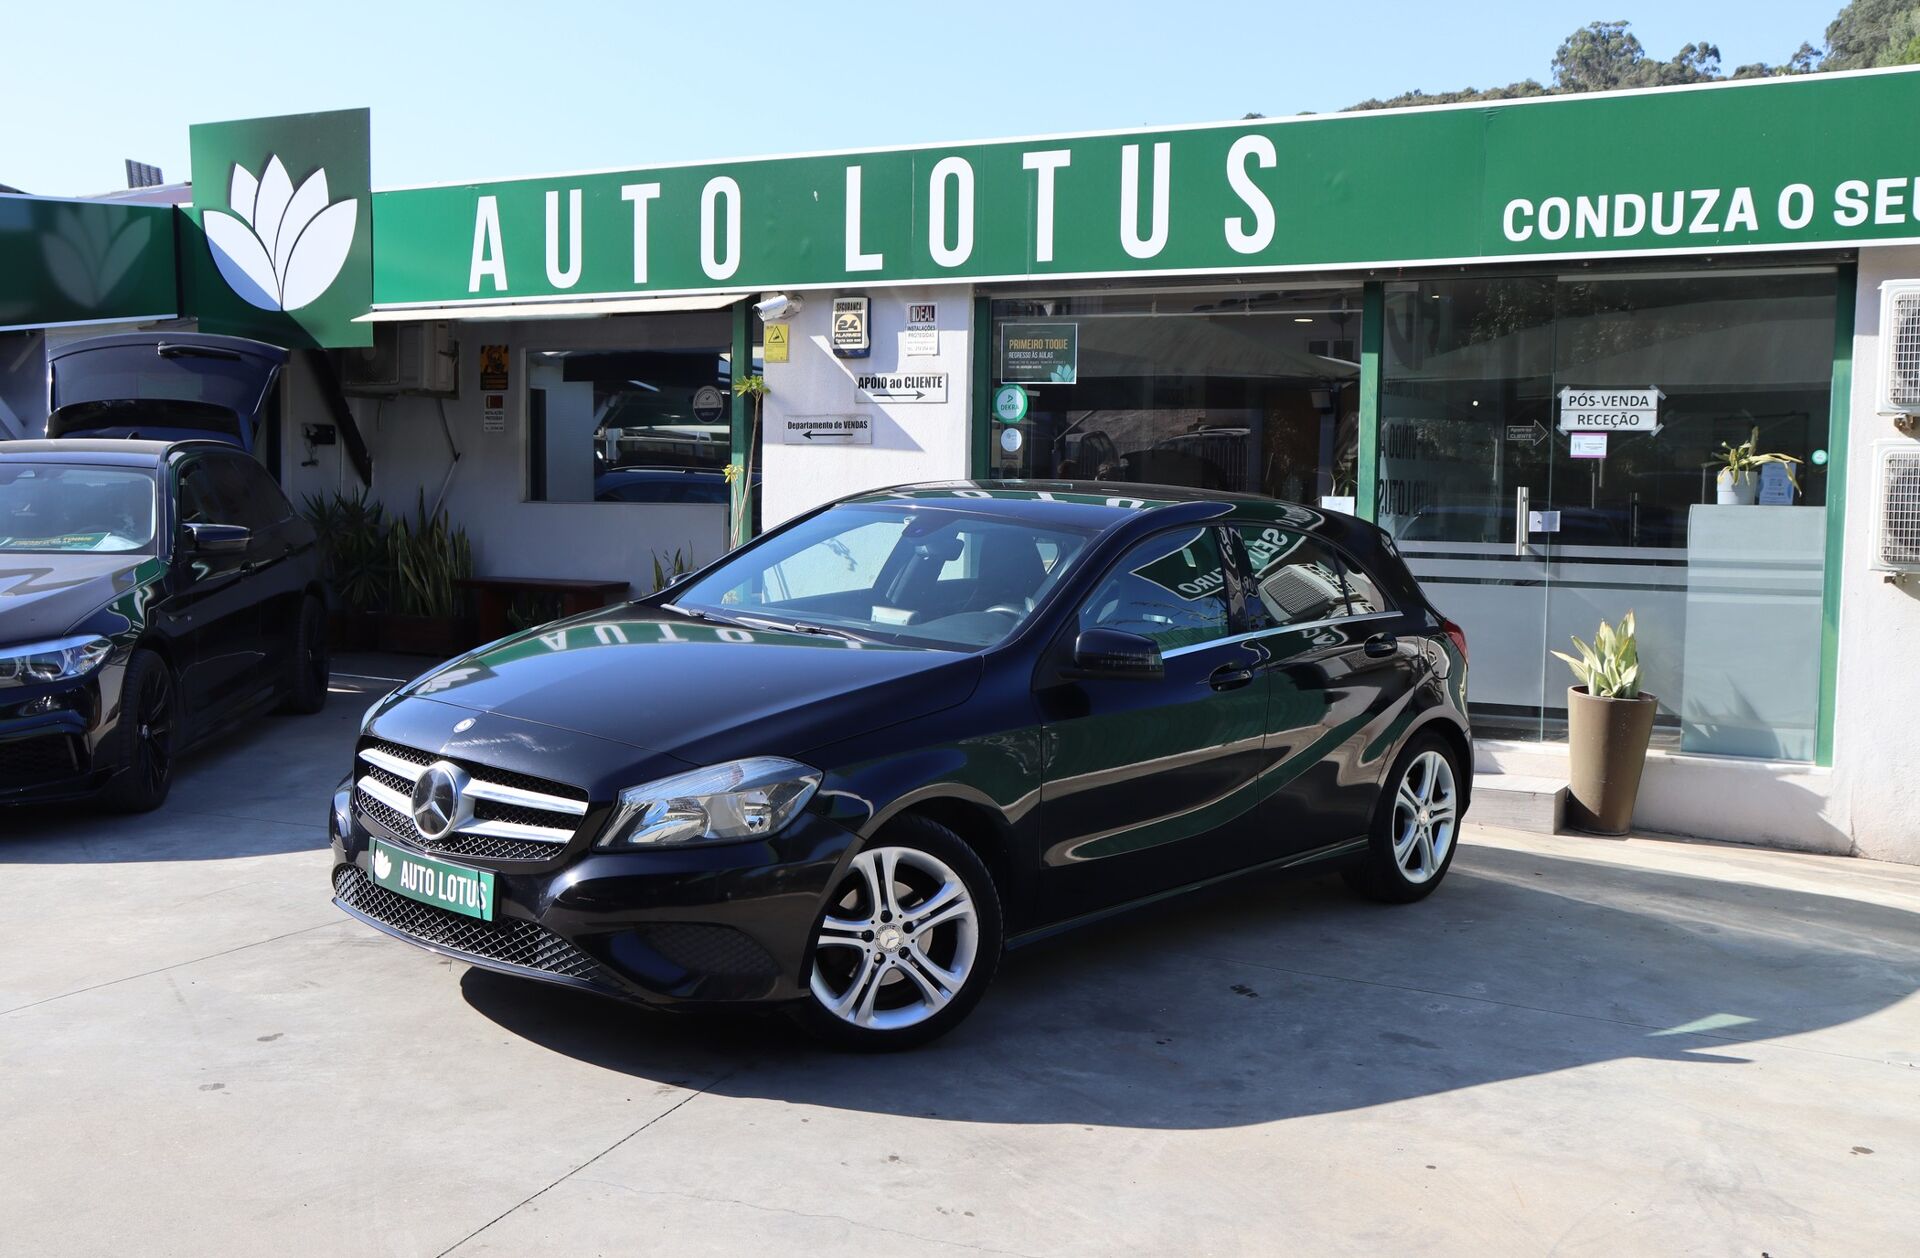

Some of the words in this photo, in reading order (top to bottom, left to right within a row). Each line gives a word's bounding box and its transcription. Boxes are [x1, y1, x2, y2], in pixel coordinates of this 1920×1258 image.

[468, 175, 742, 293] AUTO
[845, 134, 1278, 273] LOTUS
[1502, 186, 1759, 242] CONDUZA
[1777, 183, 1815, 230] O
[1833, 177, 1920, 227] SE
[911, 306, 934, 321] IDEAL
[837, 319, 858, 331] 24
[1008, 338, 1044, 349] PRIMEIRO
[1045, 338, 1068, 349] TOQUE
[858, 376, 887, 389] APOIO
[890, 378, 902, 388] ao
[904, 375, 943, 389] CLIENTE
[1568, 392, 1650, 408] PÓS-VENDA
[1000, 404, 1020, 412] DEKRA
[787, 421, 833, 431] Departamento
[834, 421, 842, 430] de
[843, 420, 868, 430] VENDAS
[1576, 411, 1640, 429] RECEÇÃO
[400, 860, 435, 897] AUTO
[438, 871, 487, 911] LOTUS
